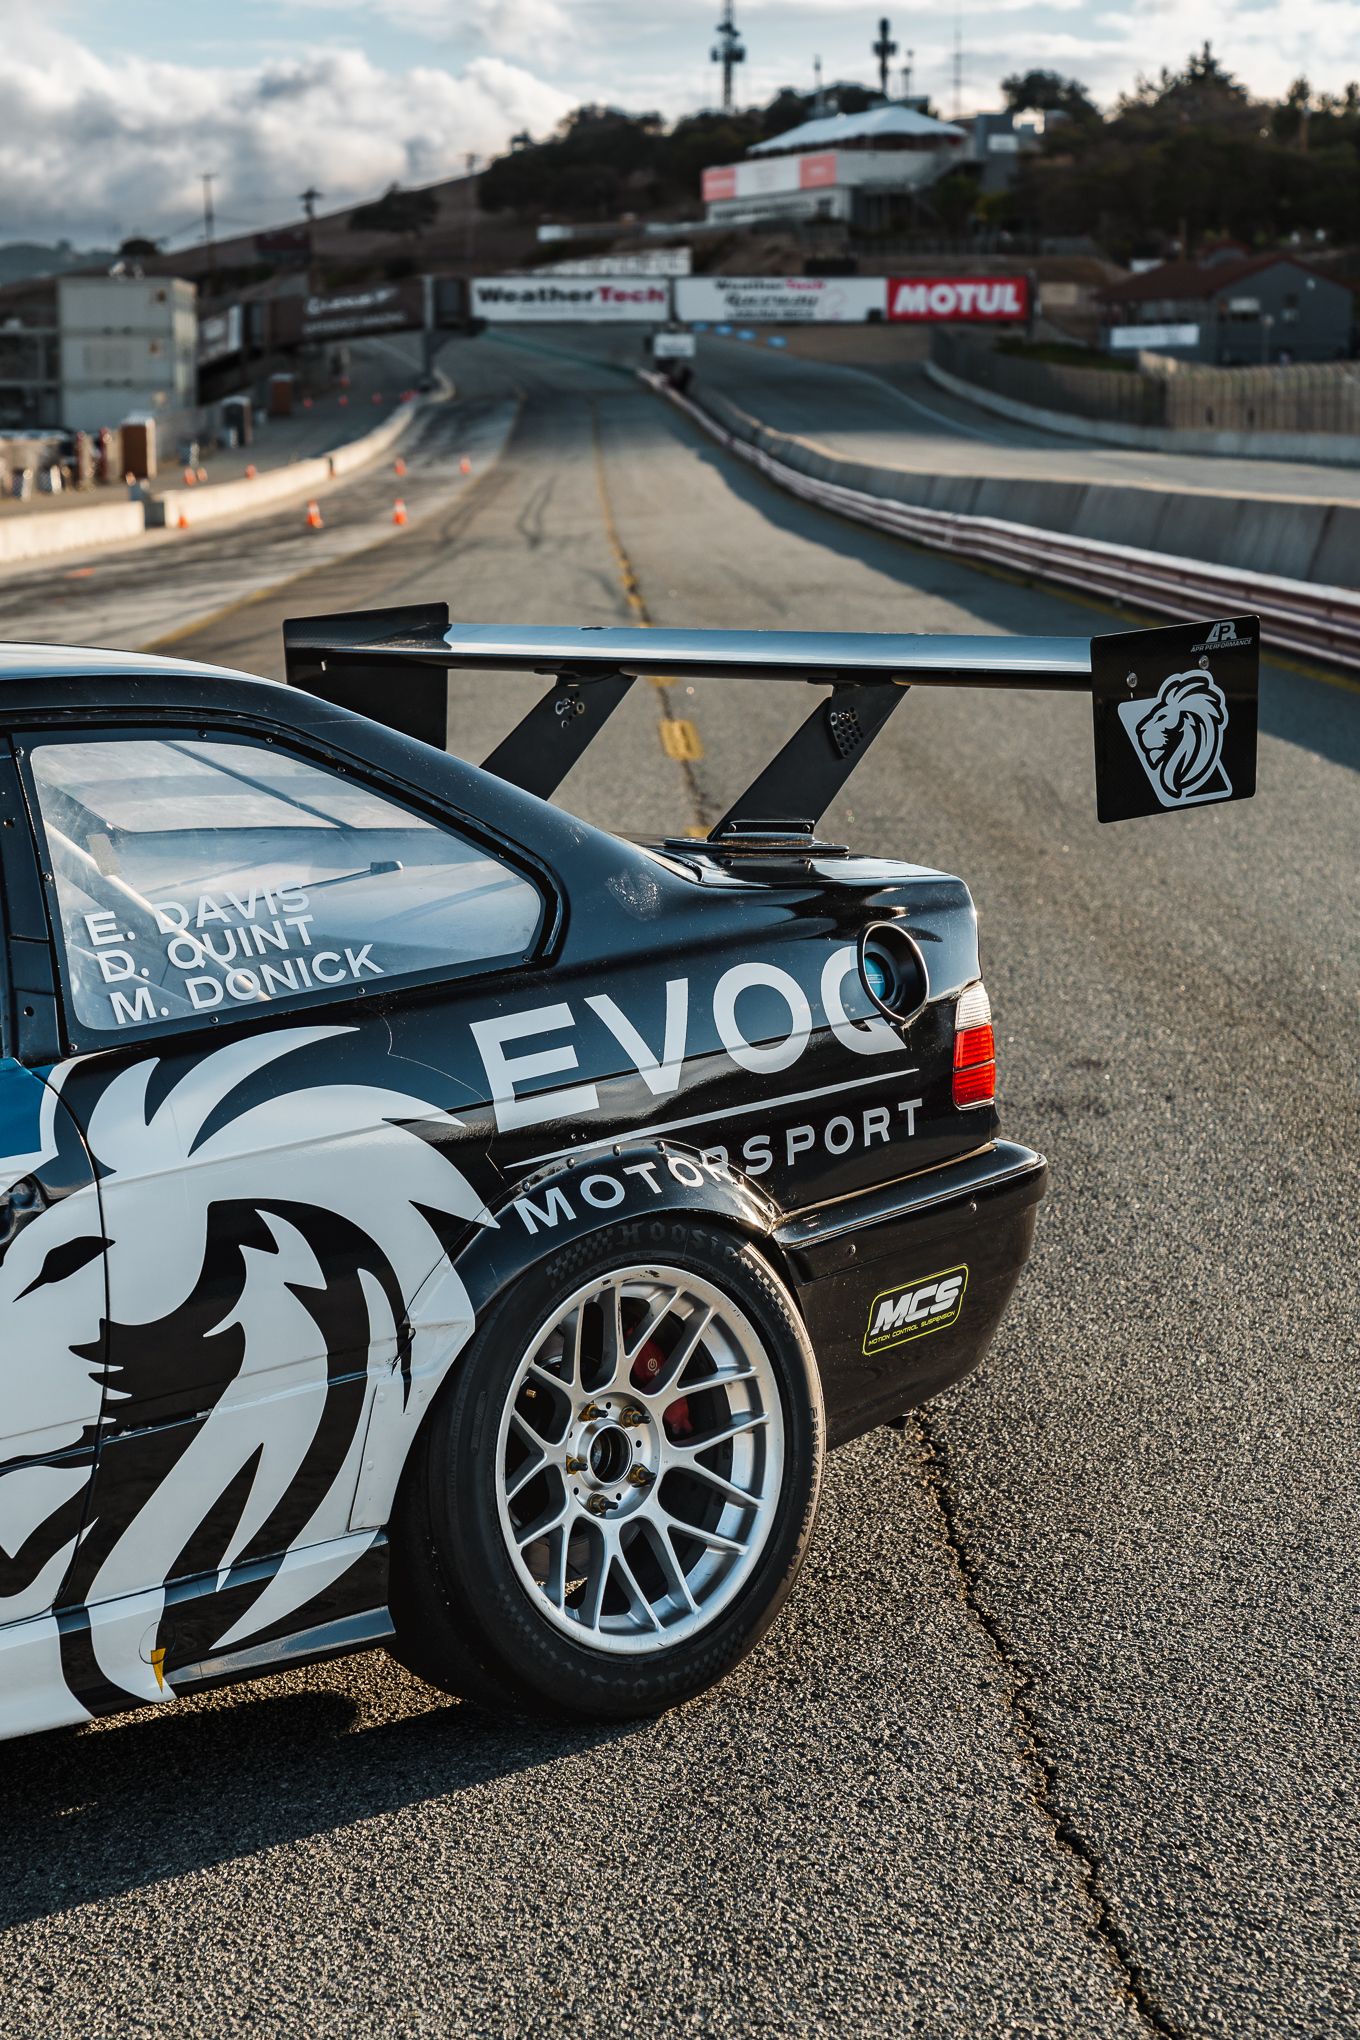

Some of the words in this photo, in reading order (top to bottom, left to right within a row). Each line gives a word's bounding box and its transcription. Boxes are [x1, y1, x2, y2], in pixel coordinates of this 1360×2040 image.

[477, 286, 667, 303] WeatherTech
[892, 284, 1019, 314] MOTUL
[1204, 639, 1252, 651] PERFORMANCE
[84, 911, 136, 946] E.
[152, 881, 310, 934] DAVIS
[97, 950, 149, 983] D.
[167, 915, 314, 970] QUINT
[109, 987, 169, 1025] M.
[184, 943, 385, 1009] DONICK
[512, 1098, 923, 1235] MOTORSPORT
[868, 1334, 891, 1345] MOTION
[892, 1324, 919, 1338] CONTROL
[920, 1310, 956, 1327] SUSPENSION
[870, 1275, 963, 1336] MCS
